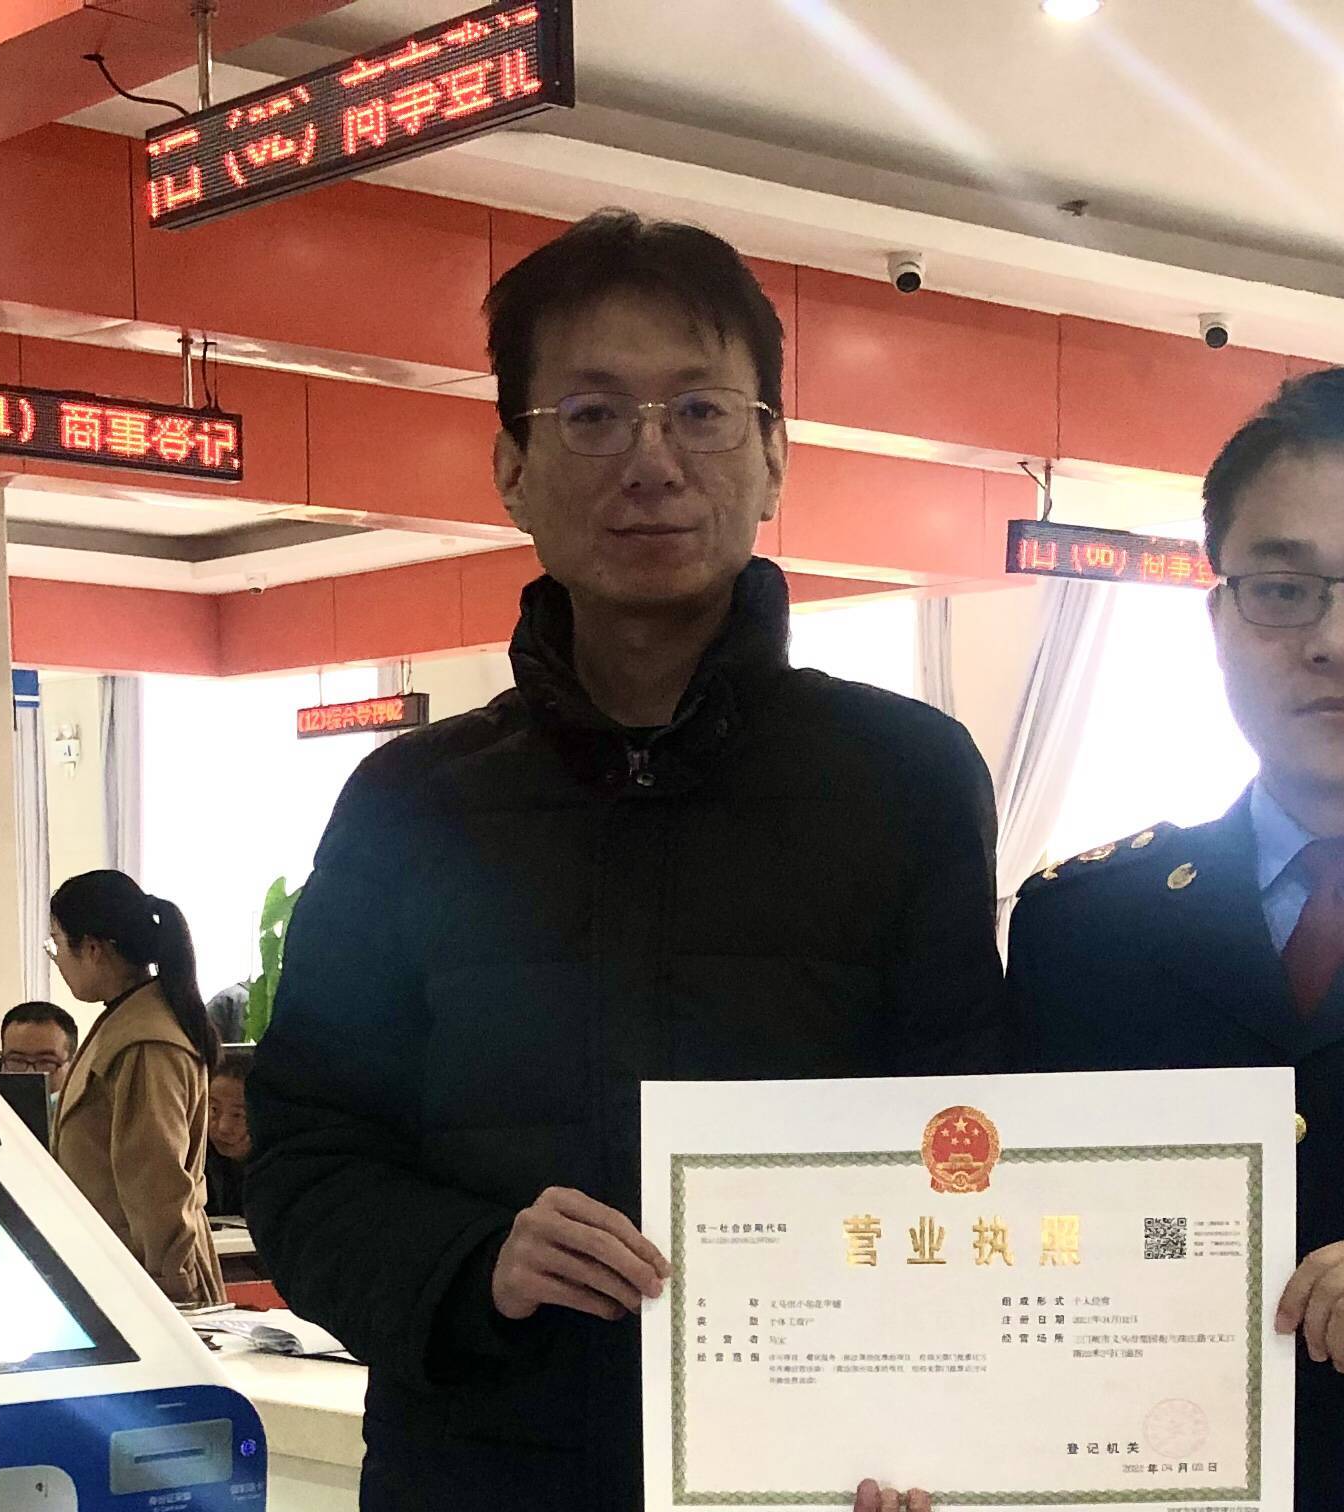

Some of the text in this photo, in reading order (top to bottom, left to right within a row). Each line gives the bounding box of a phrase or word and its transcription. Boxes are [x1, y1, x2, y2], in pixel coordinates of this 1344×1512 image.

[59, 400, 241, 471] 商事登记
[843, 1213, 1081, 1266] 营业执照
[1067, 1441, 1140, 1455] 登记机关
